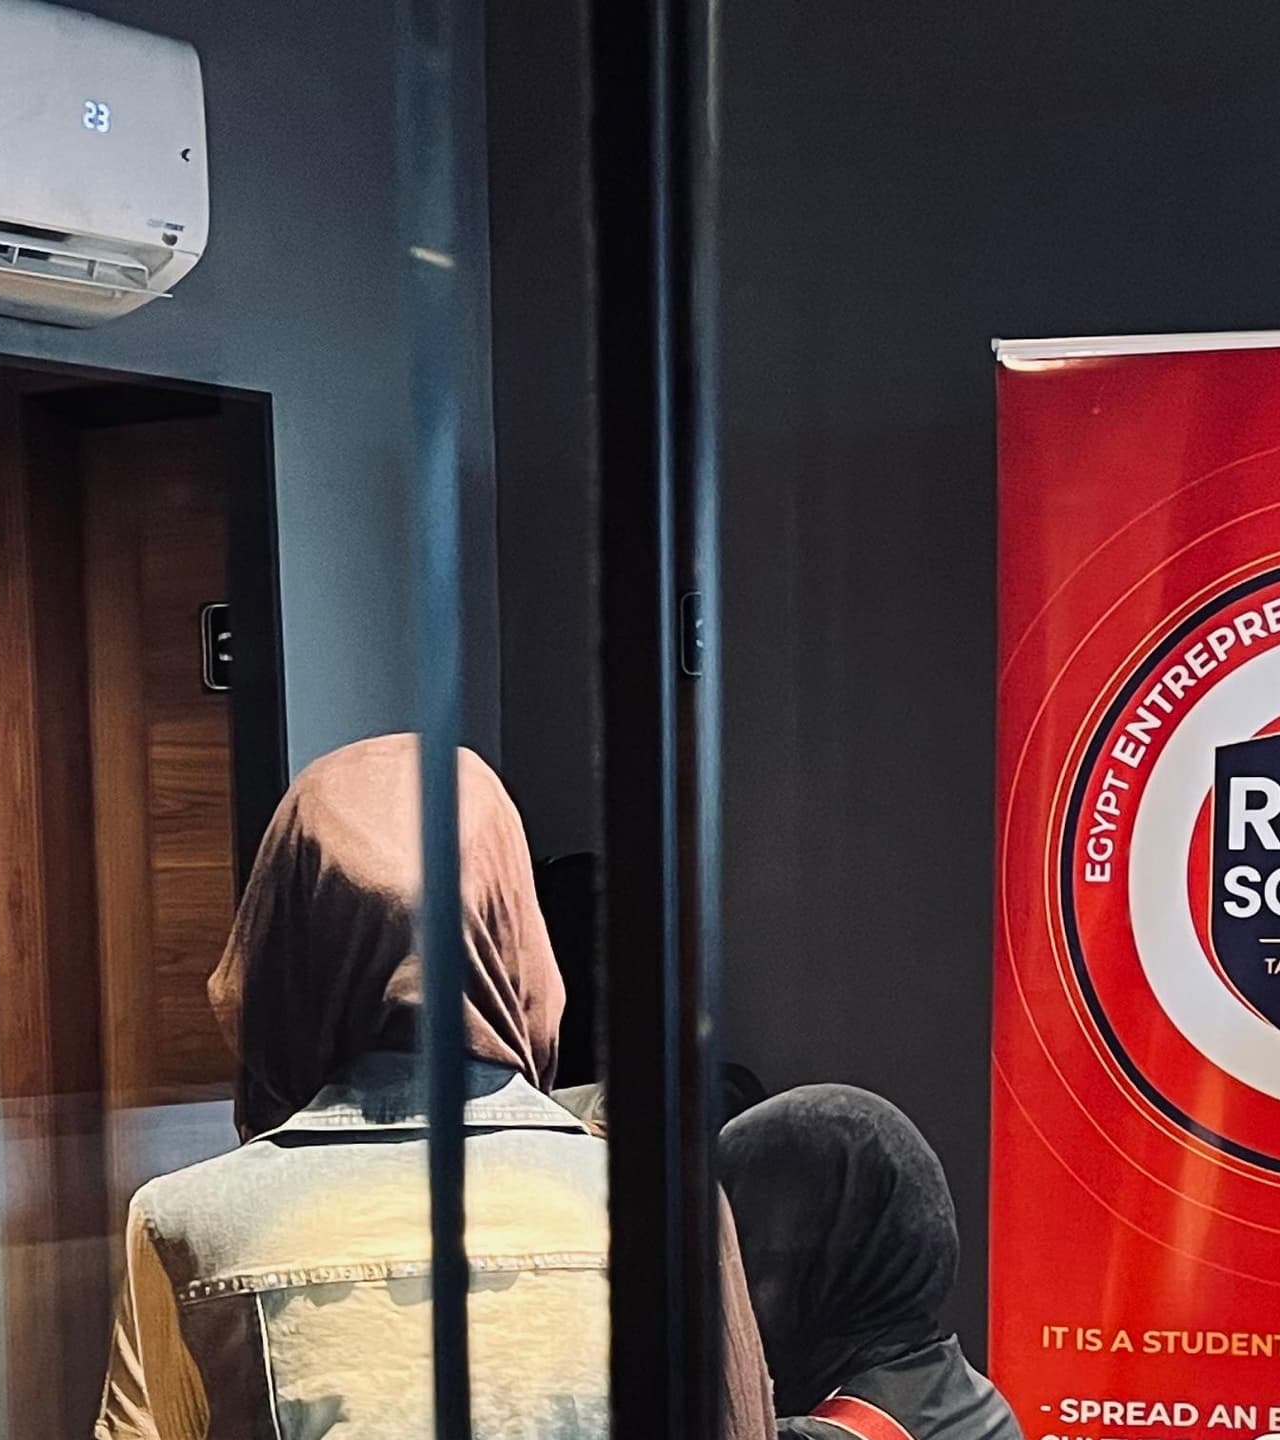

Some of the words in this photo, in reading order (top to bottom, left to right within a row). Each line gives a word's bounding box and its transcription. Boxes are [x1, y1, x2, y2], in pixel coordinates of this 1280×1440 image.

[83, 101, 110, 132] 23
[1085, 769, 1129, 883] EGYPT
[1042, 1325, 1069, 1350] IT
[1076, 1327, 1103, 1351] IS
[1110, 1329, 1134, 1353] A
[1059, 1398, 1199, 1427] SPREAD
[1207, 1404, 1257, 1430] AN
